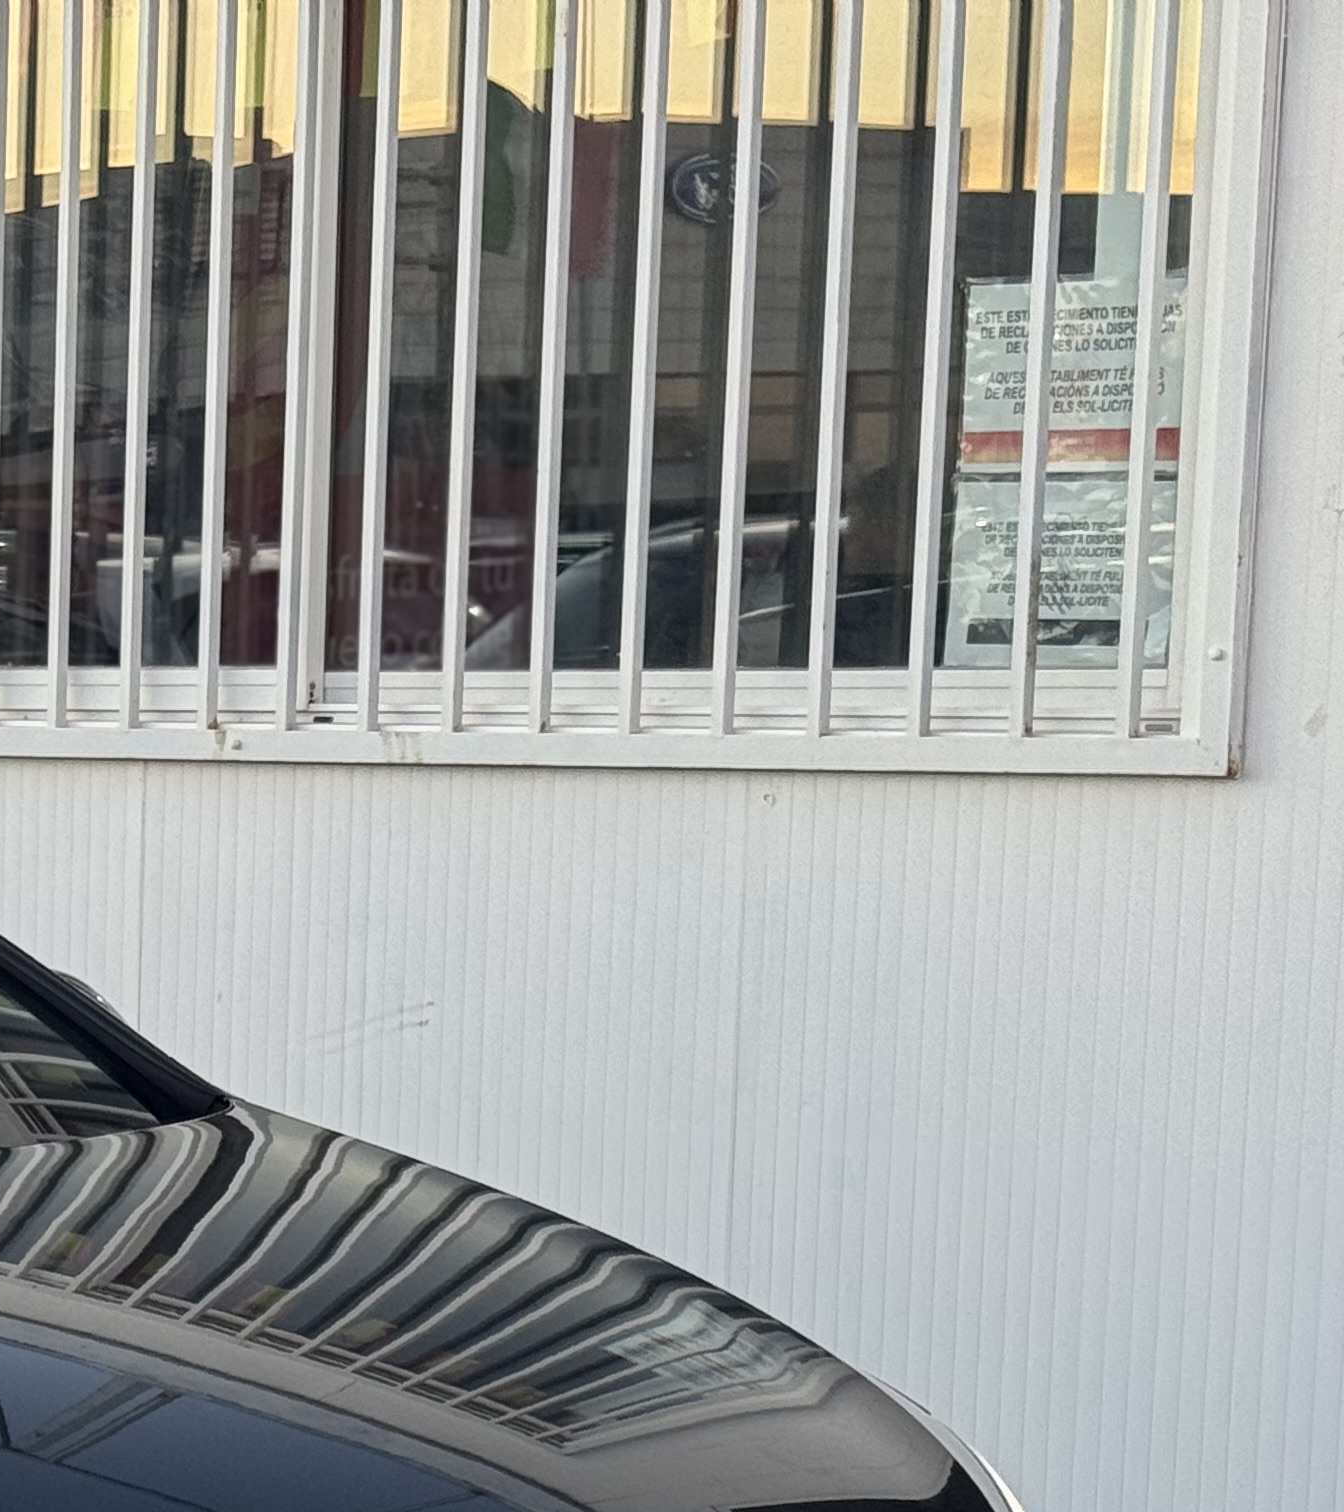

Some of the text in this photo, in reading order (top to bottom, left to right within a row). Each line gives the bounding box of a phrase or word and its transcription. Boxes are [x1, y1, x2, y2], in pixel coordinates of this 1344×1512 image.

[975, 310, 1005, 325] ESTE
[1109, 304, 1138, 320] TIEN
[980, 326, 996, 339] DE
[998, 321, 1094, 340] RECLCIONES
[1096, 320, 1105, 335] A
[1005, 341, 1021, 354] DE
[1075, 338, 1090, 352] LO
[1092, 337, 1137, 351] SOLICIT
[988, 370, 1027, 385] AQUES
[984, 387, 1000, 400] DE
[1091, 384, 1100, 396] A
[1052, 400, 1073, 414] ELS
